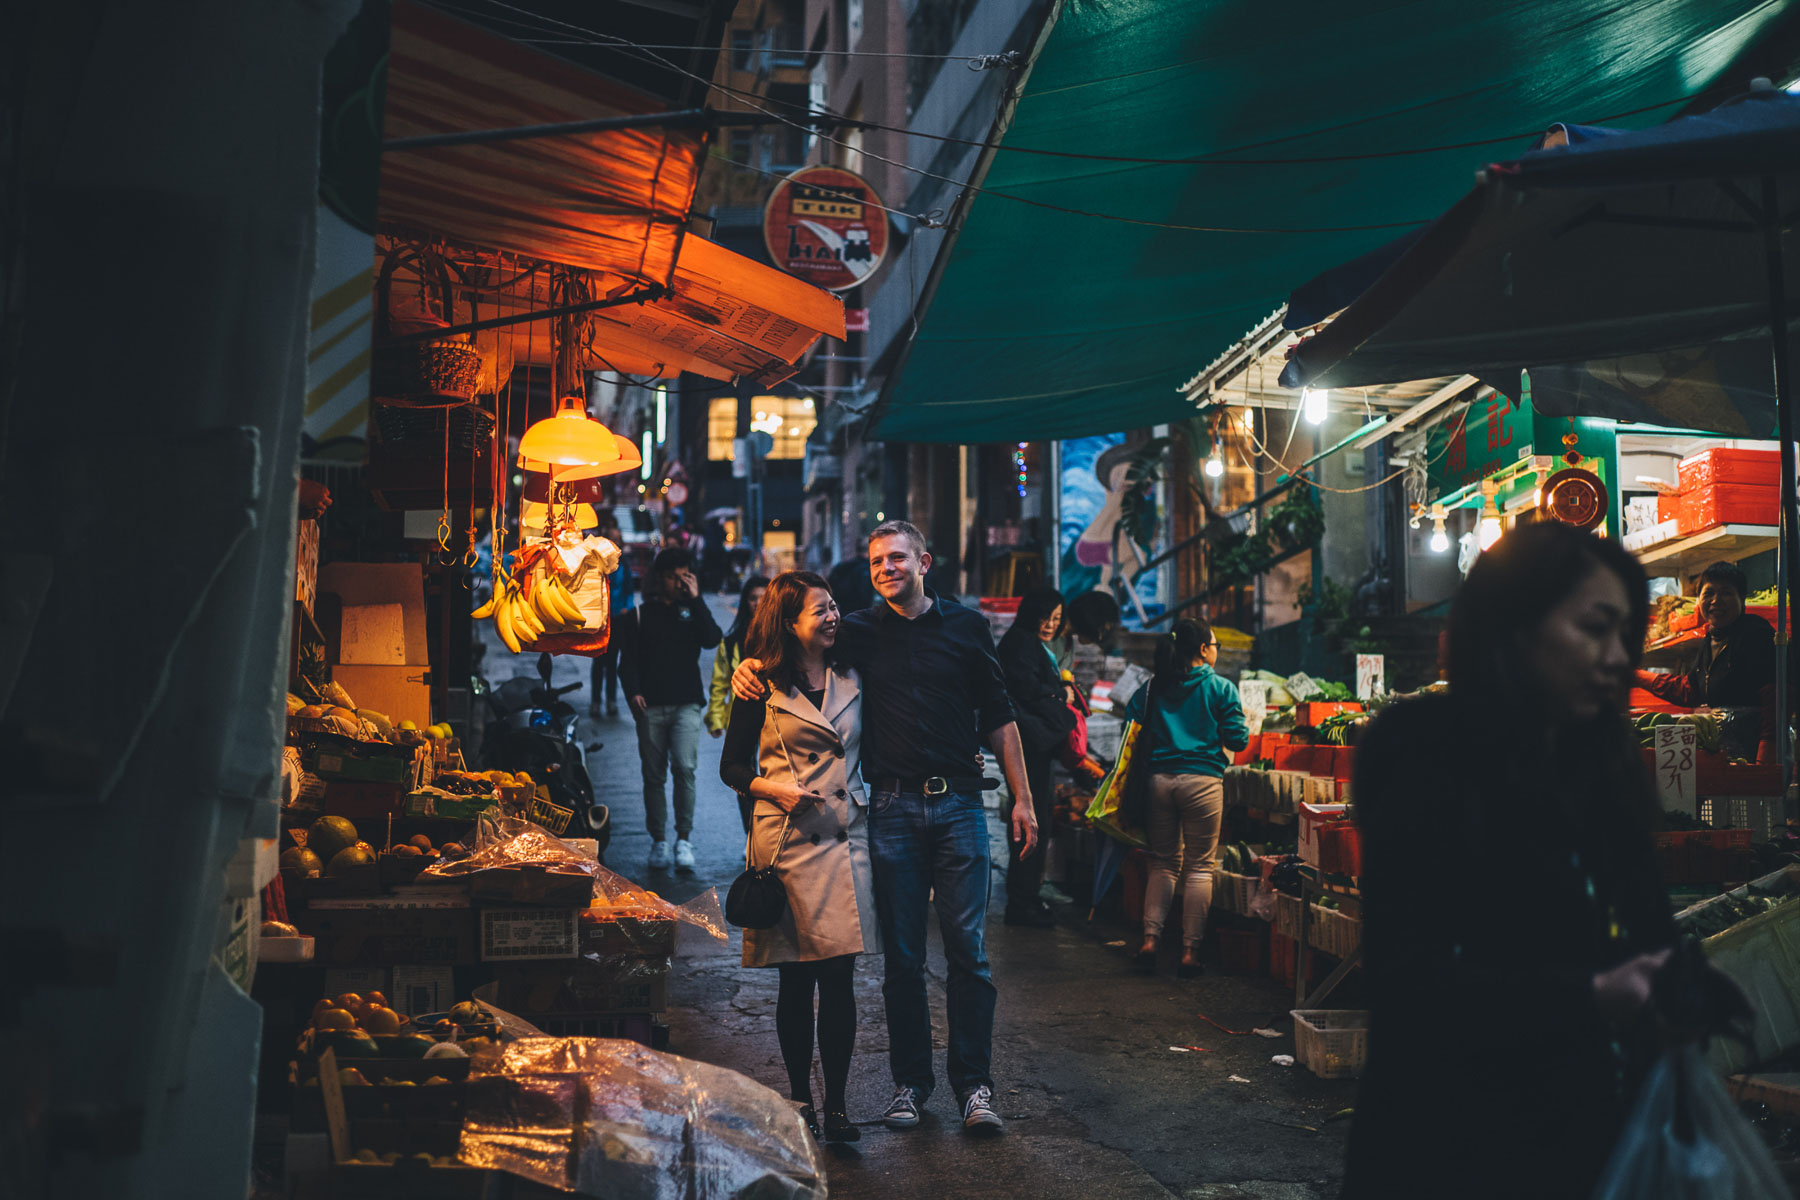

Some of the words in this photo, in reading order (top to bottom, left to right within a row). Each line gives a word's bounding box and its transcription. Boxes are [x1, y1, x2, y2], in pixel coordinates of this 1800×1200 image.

[797, 202, 857, 215] TUK
[1657, 726, 1696, 748] 豆苗
[1660, 747, 1693, 771] 28
